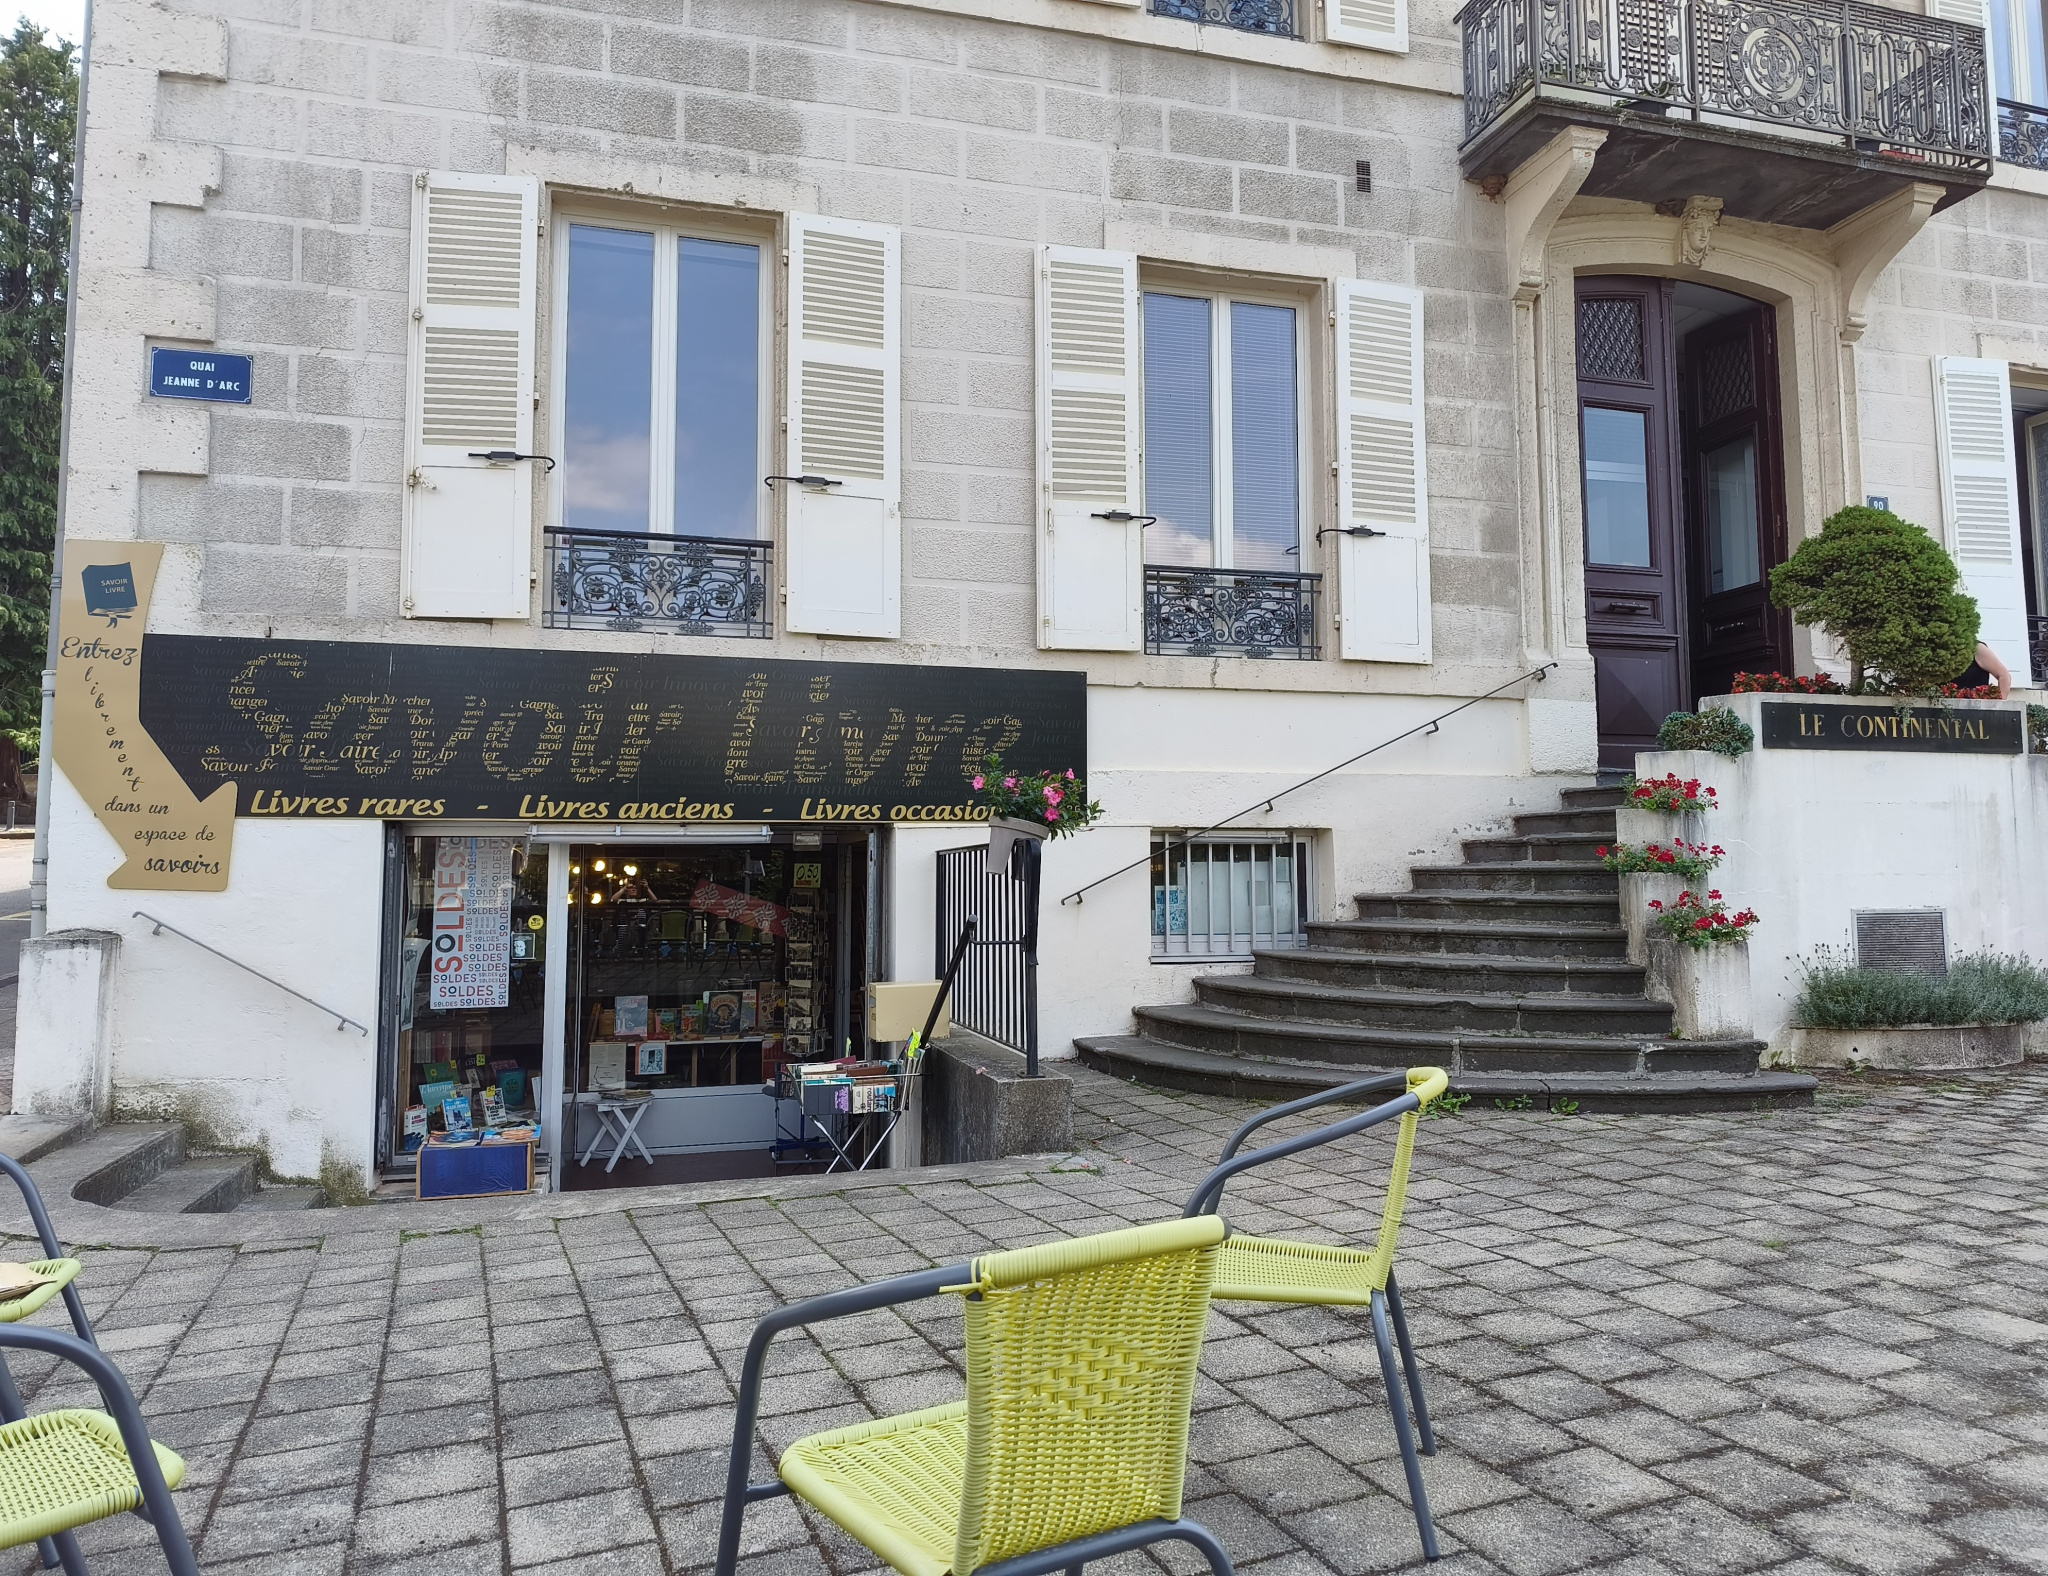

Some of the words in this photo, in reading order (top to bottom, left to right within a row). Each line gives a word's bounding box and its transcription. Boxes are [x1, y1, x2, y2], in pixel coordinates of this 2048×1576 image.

[190, 361, 215, 372] QUAI
[163, 376, 200, 388] JEANNE
[206, 380, 240, 391] D'ARC
[1873, 501, 1884, 511] 90
[101, 578, 128, 586] SAVOIR
[105, 586, 126, 594] LIVRE
[60, 636, 138, 666] Entrez
[1800, 713, 1826, 737] LE
[1840, 714, 1990, 740] CONTINENTAL
[200, 757, 252, 773] Savoir
[733, 772, 761, 781] Savoir
[104, 796, 142, 813] dans
[148, 802, 170, 814] un
[250, 789, 350, 815] Livres
[358, 797, 446, 816] rares
[518, 794, 610, 819] Livres
[618, 796, 735, 819] anciens
[800, 797, 882, 821] Livres
[134, 828, 188, 846] espace
[195, 825, 216, 842] de
[143, 854, 222, 875] savoirs
[467, 851, 477, 889] SOLDES
[491, 849, 502, 888] SOLDES
[480, 860, 488, 888] SOLDES
[469, 889, 509, 898] SOLDES
[466, 899, 498, 907] SOLDES
[434, 851, 466, 973] SOLDES
[466, 907, 499, 915] SOLDES
[499, 900, 509, 937] SOLDES
[465, 917, 473, 943] SOLDES
[469, 943, 508, 952] SOLDES
[463, 953, 503, 962] SOLDES
[468, 963, 508, 972] SOLDES
[433, 973, 477, 984] SOLDES
[439, 985, 494, 997] SOLDES
[498, 972, 507, 1005] SOLDES
[460, 998, 496, 1006] SOLDES
